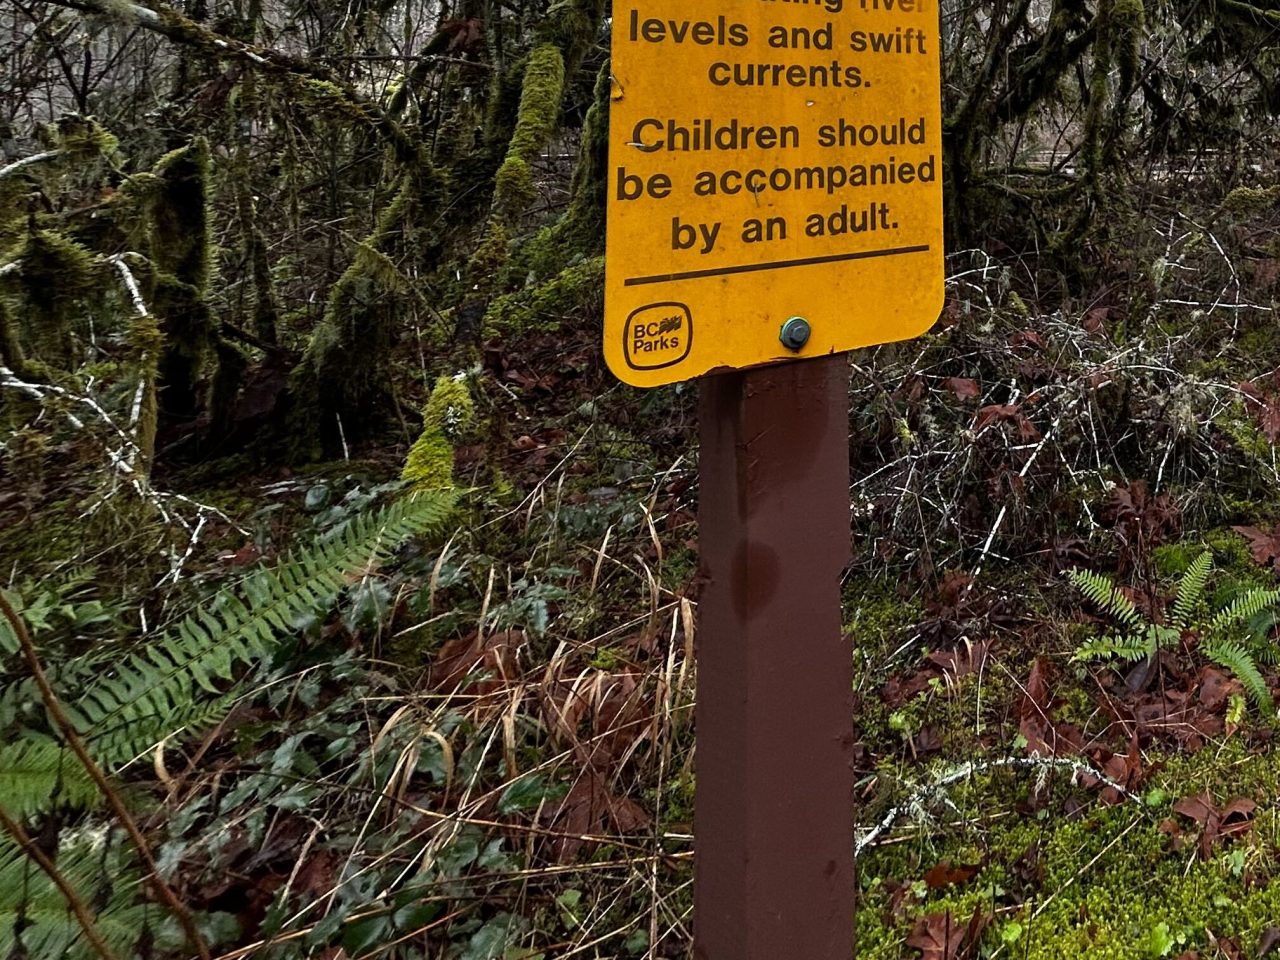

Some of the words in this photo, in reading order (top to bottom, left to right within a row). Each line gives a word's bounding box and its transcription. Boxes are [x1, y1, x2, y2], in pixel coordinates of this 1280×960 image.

[629, 10, 749, 47] levels
[768, 23, 833, 51] and
[850, 26, 927, 55] swift
[708, 60, 871, 88] currents.
[632, 118, 799, 152] Children
[818, 117, 926, 148] should
[616, 167, 672, 200] be
[694, 155, 936, 194] accompanied
[671, 217, 721, 254] by
[741, 215, 787, 243] an
[805, 202, 899, 237] adult.
[633, 336, 679, 355] Parks
[634, 322, 659, 339] BC
